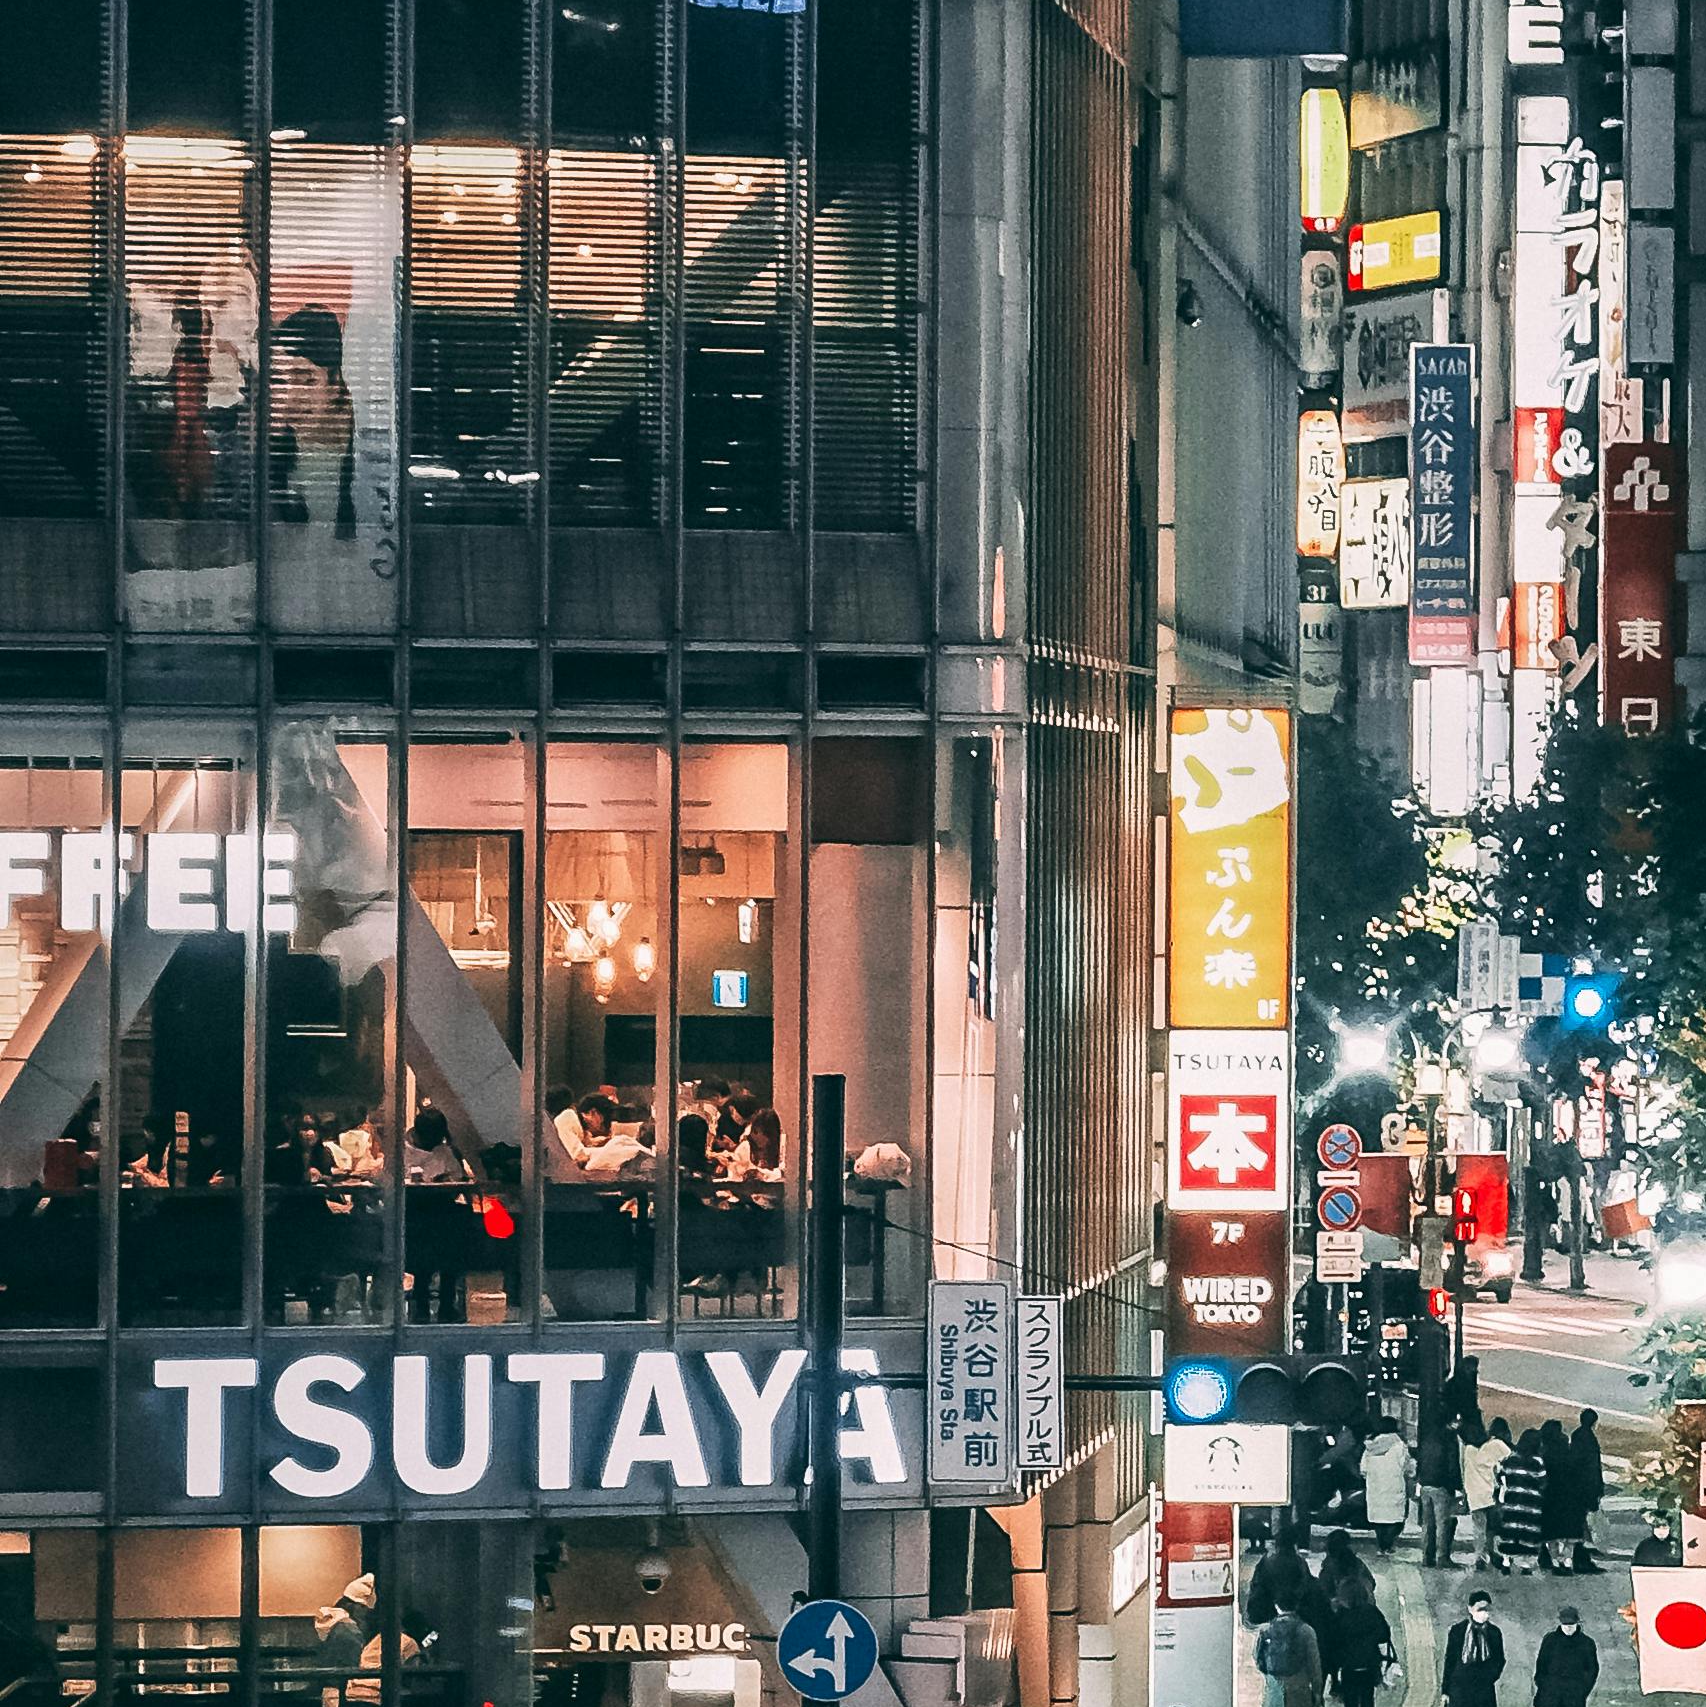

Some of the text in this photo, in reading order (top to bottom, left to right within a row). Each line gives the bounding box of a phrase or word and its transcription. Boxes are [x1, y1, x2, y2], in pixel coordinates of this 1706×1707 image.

[1419, 386, 1455, 546] 渋谷整形
[1174, 1054, 1283, 1071] TSUTAYA
[1186, 1102, 1268, 1183] 本
[1210, 1222, 1246, 1245] 7F
[1182, 1276, 1275, 1304] WIRED
[1193, 1303, 1263, 1325] TOKYO
[153, 1348, 910, 1498] TSUTAYA
[937, 1325, 959, 1447] Shibuya Sta.
[963, 1299, 999, 1467] 渋谷駅前
[1025, 1304, 1054, 1463] スクランブル式
[569, 1623, 752, 1652] STARBUC
